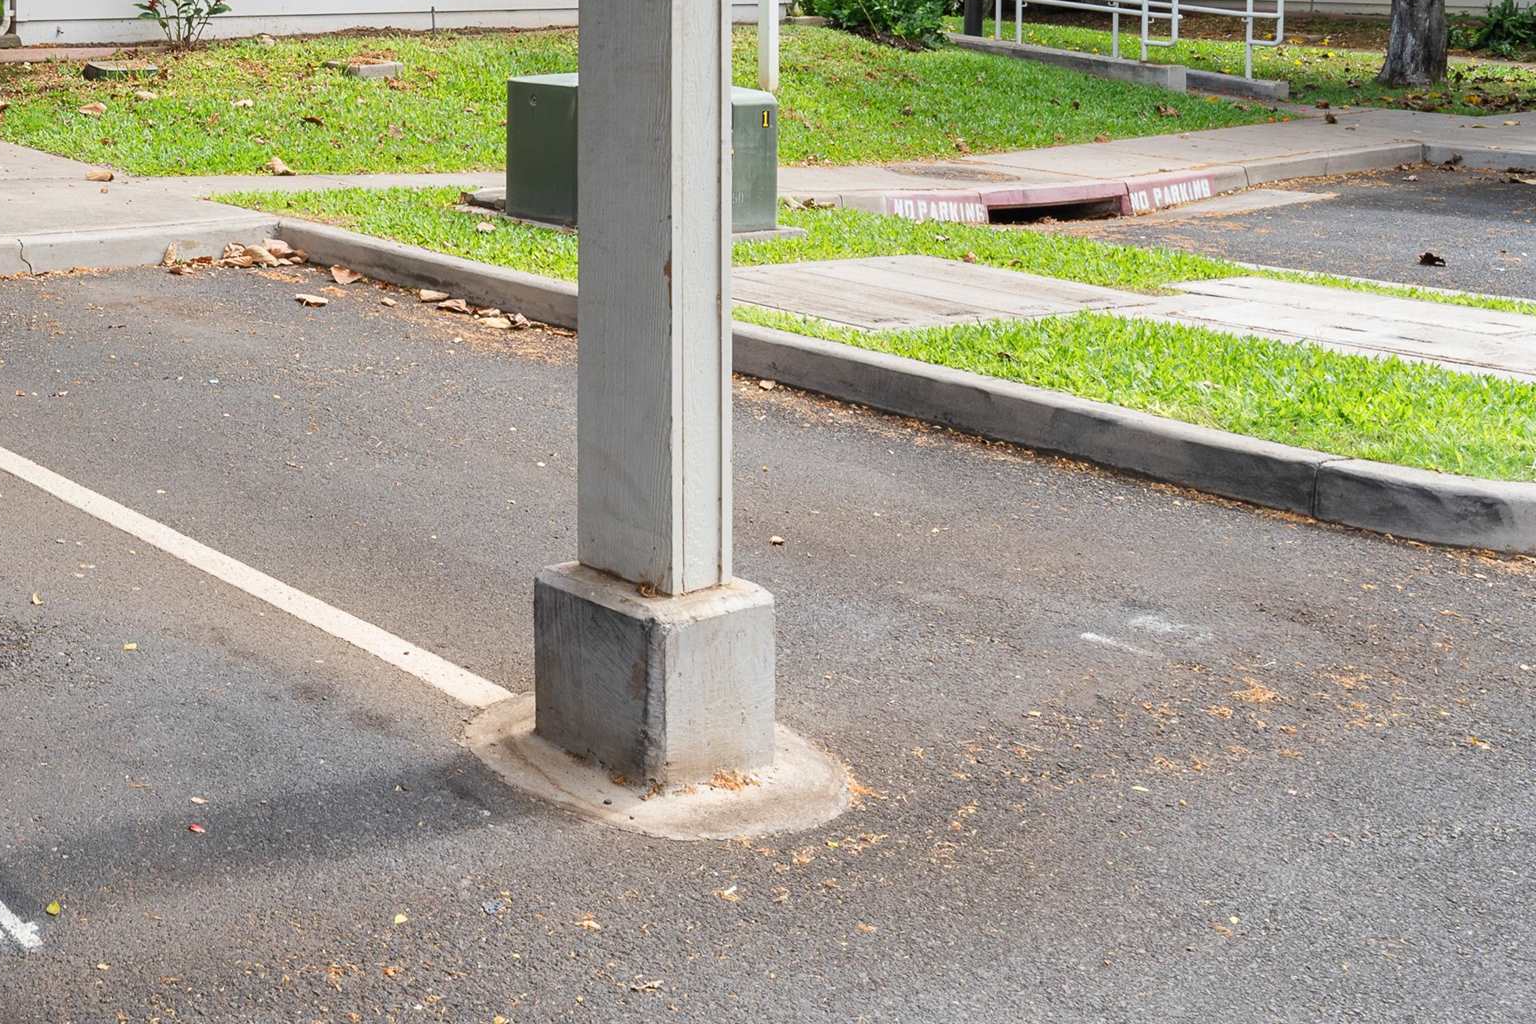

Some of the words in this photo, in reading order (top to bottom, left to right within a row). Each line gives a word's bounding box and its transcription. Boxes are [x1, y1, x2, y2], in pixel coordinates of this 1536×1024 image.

[1130, 190, 1149, 209] NO
[1153, 178, 1211, 206] PARKING
[895, 198, 913, 218] NO
[916, 200, 984, 222] PARKING
